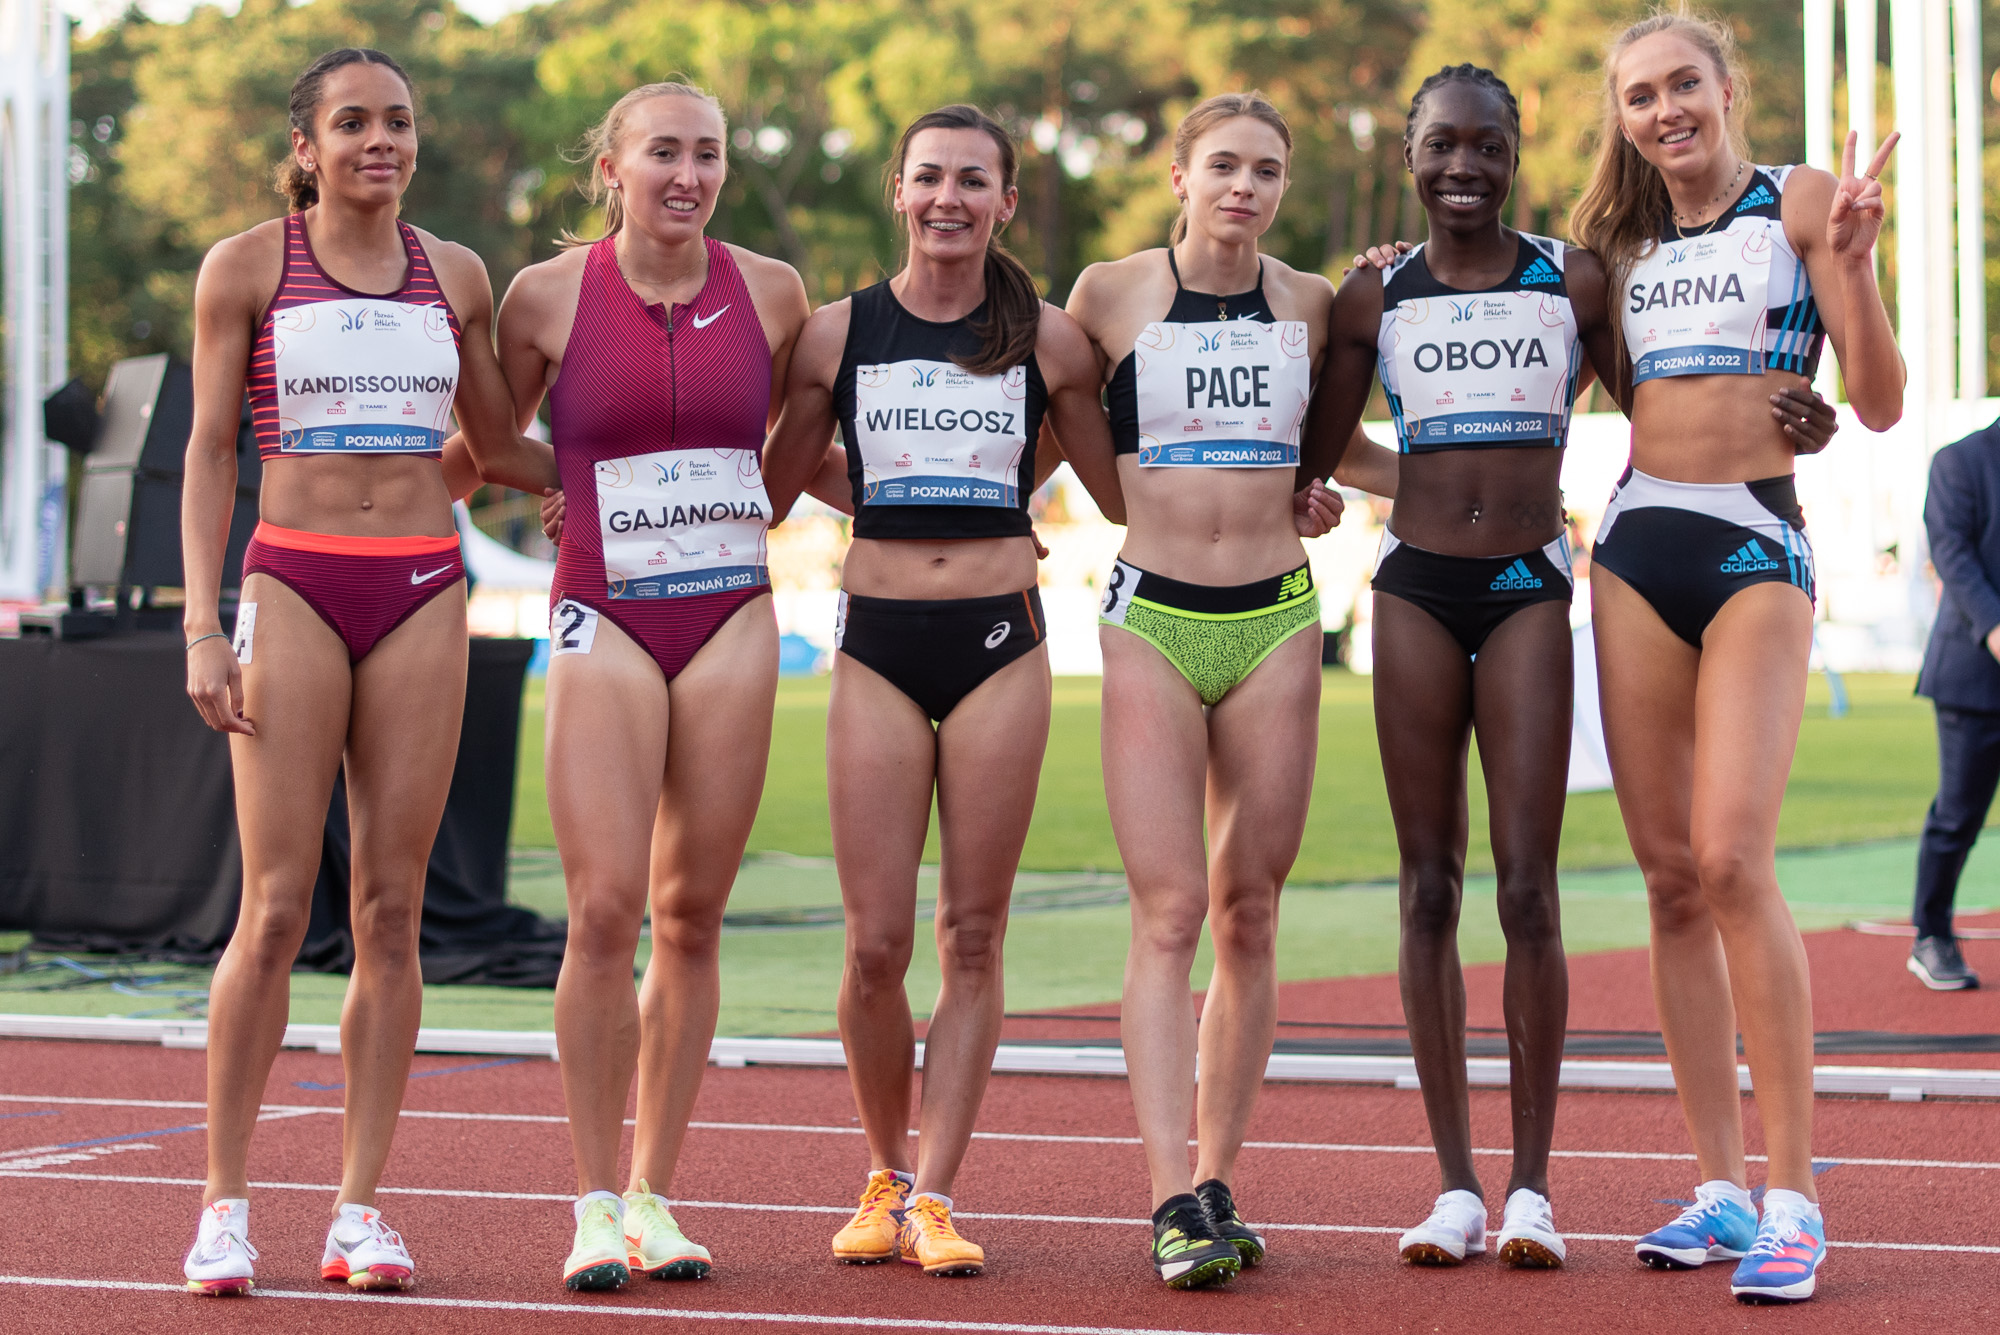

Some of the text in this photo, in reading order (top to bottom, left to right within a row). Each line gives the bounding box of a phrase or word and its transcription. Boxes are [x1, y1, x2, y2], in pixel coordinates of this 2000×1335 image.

[1736, 195, 1775, 213] adidas
[1520, 272, 1561, 285] adidas
[1629, 273, 1746, 314] SARNA
[374, 319, 401, 327] Athletics
[1413, 338, 1549, 373] OBOYA
[1654, 353, 1705, 371] POZNAŃ
[1708, 354, 1741, 366] 2022
[284, 375, 454, 396] KANDISSOUNON
[1186, 365, 1271, 409] PACE
[866, 408, 1016, 435] WIELGOSZ
[1453, 419, 1543, 435] POZNAŃ 2022
[345, 433, 426, 447] POZNAŃ 2022
[1202, 448, 1282, 462] POZNAŃ 2022
[689, 468, 718, 477] Athletics
[910, 485, 1000, 500] POZNAŃ 2022
[608, 501, 764, 533] GAJANOVA
[1720, 558, 1779, 573] adidas
[667, 573, 753, 595] POZNAŃ 2022
[1489, 577, 1543, 591] adidas
[555, 604, 586, 651] 2
